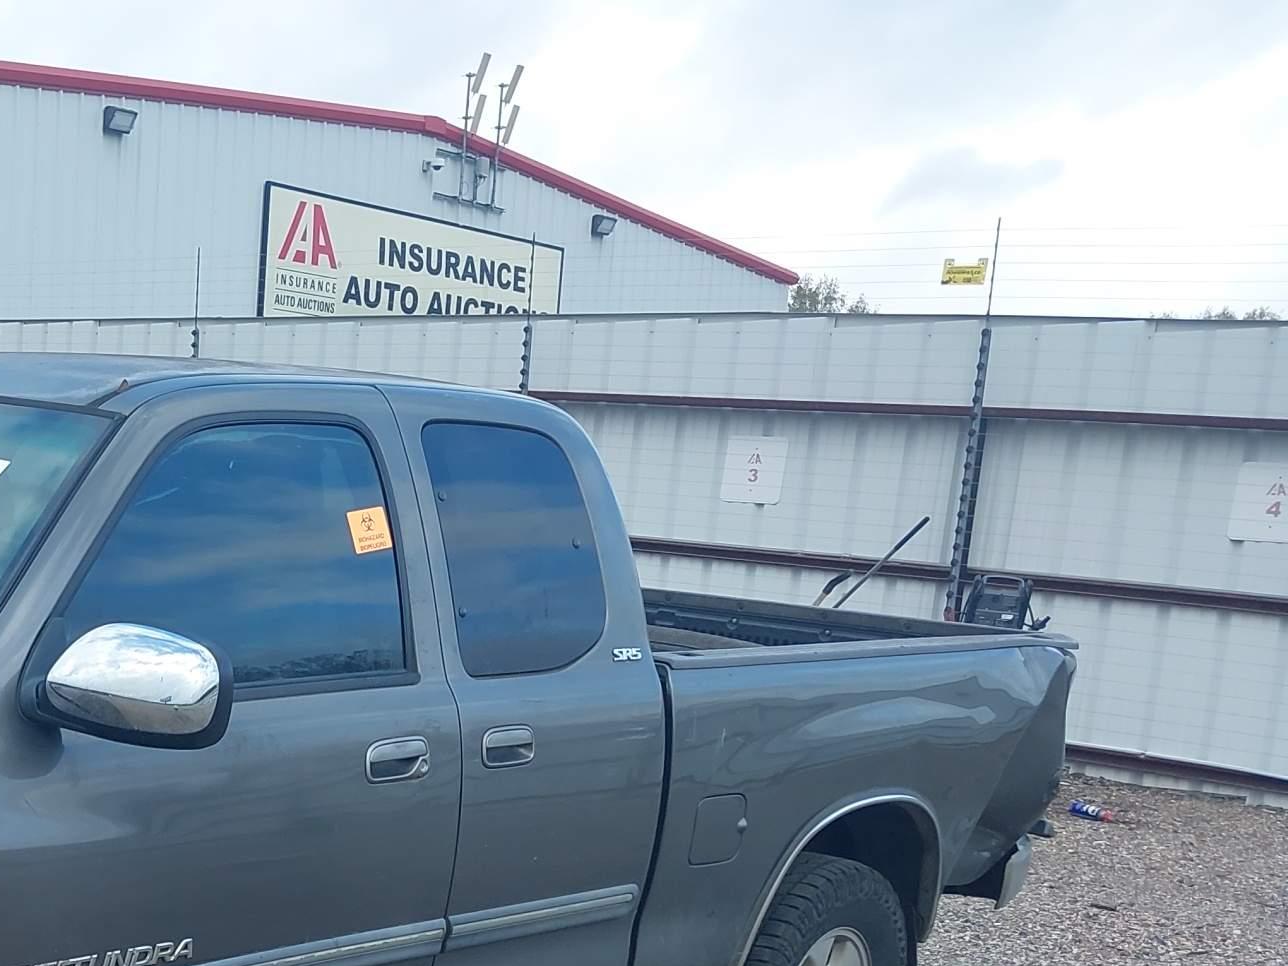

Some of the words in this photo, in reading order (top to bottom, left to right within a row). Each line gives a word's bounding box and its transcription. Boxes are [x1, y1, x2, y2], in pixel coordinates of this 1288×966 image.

[378, 236, 527, 294] INSURANCE
[275, 272, 337, 294] INSURANCE
[274, 294, 296, 307] AUTO
[297, 297, 336, 314] AUCTIONS
[342, 275, 419, 315] AUTO
[747, 468, 759, 483] 3
[1265, 500, 1282, 518] 4
[613, 647, 642, 662] SR5
